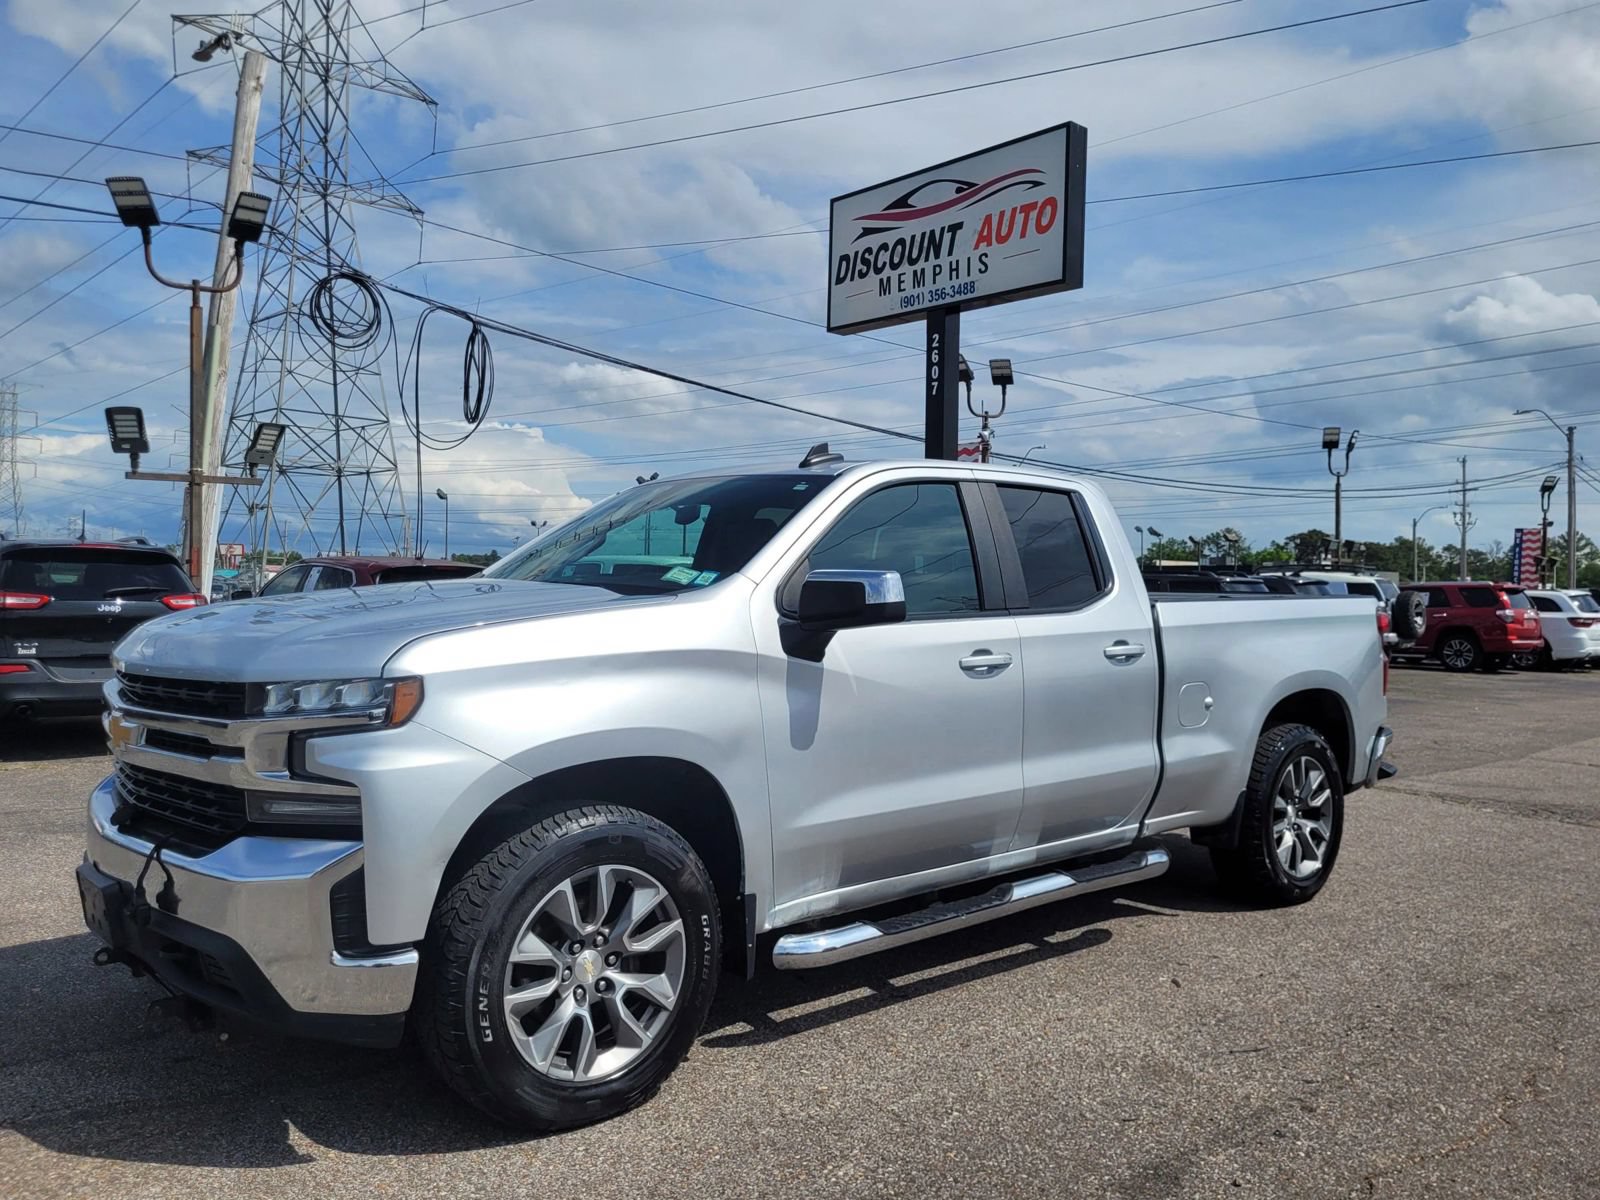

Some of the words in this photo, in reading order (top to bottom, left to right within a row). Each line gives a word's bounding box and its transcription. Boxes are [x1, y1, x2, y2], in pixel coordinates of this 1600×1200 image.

[835, 221, 964, 286] DISCOUNT
[973, 196, 1058, 251] AUTO
[878, 253, 989, 297] MEMPHIS
[900, 295, 925, 310] (901)
[928, 281, 976, 303] 356-3488
[931, 333, 939, 396] 2607
[97, 604, 122, 613] Jeep
